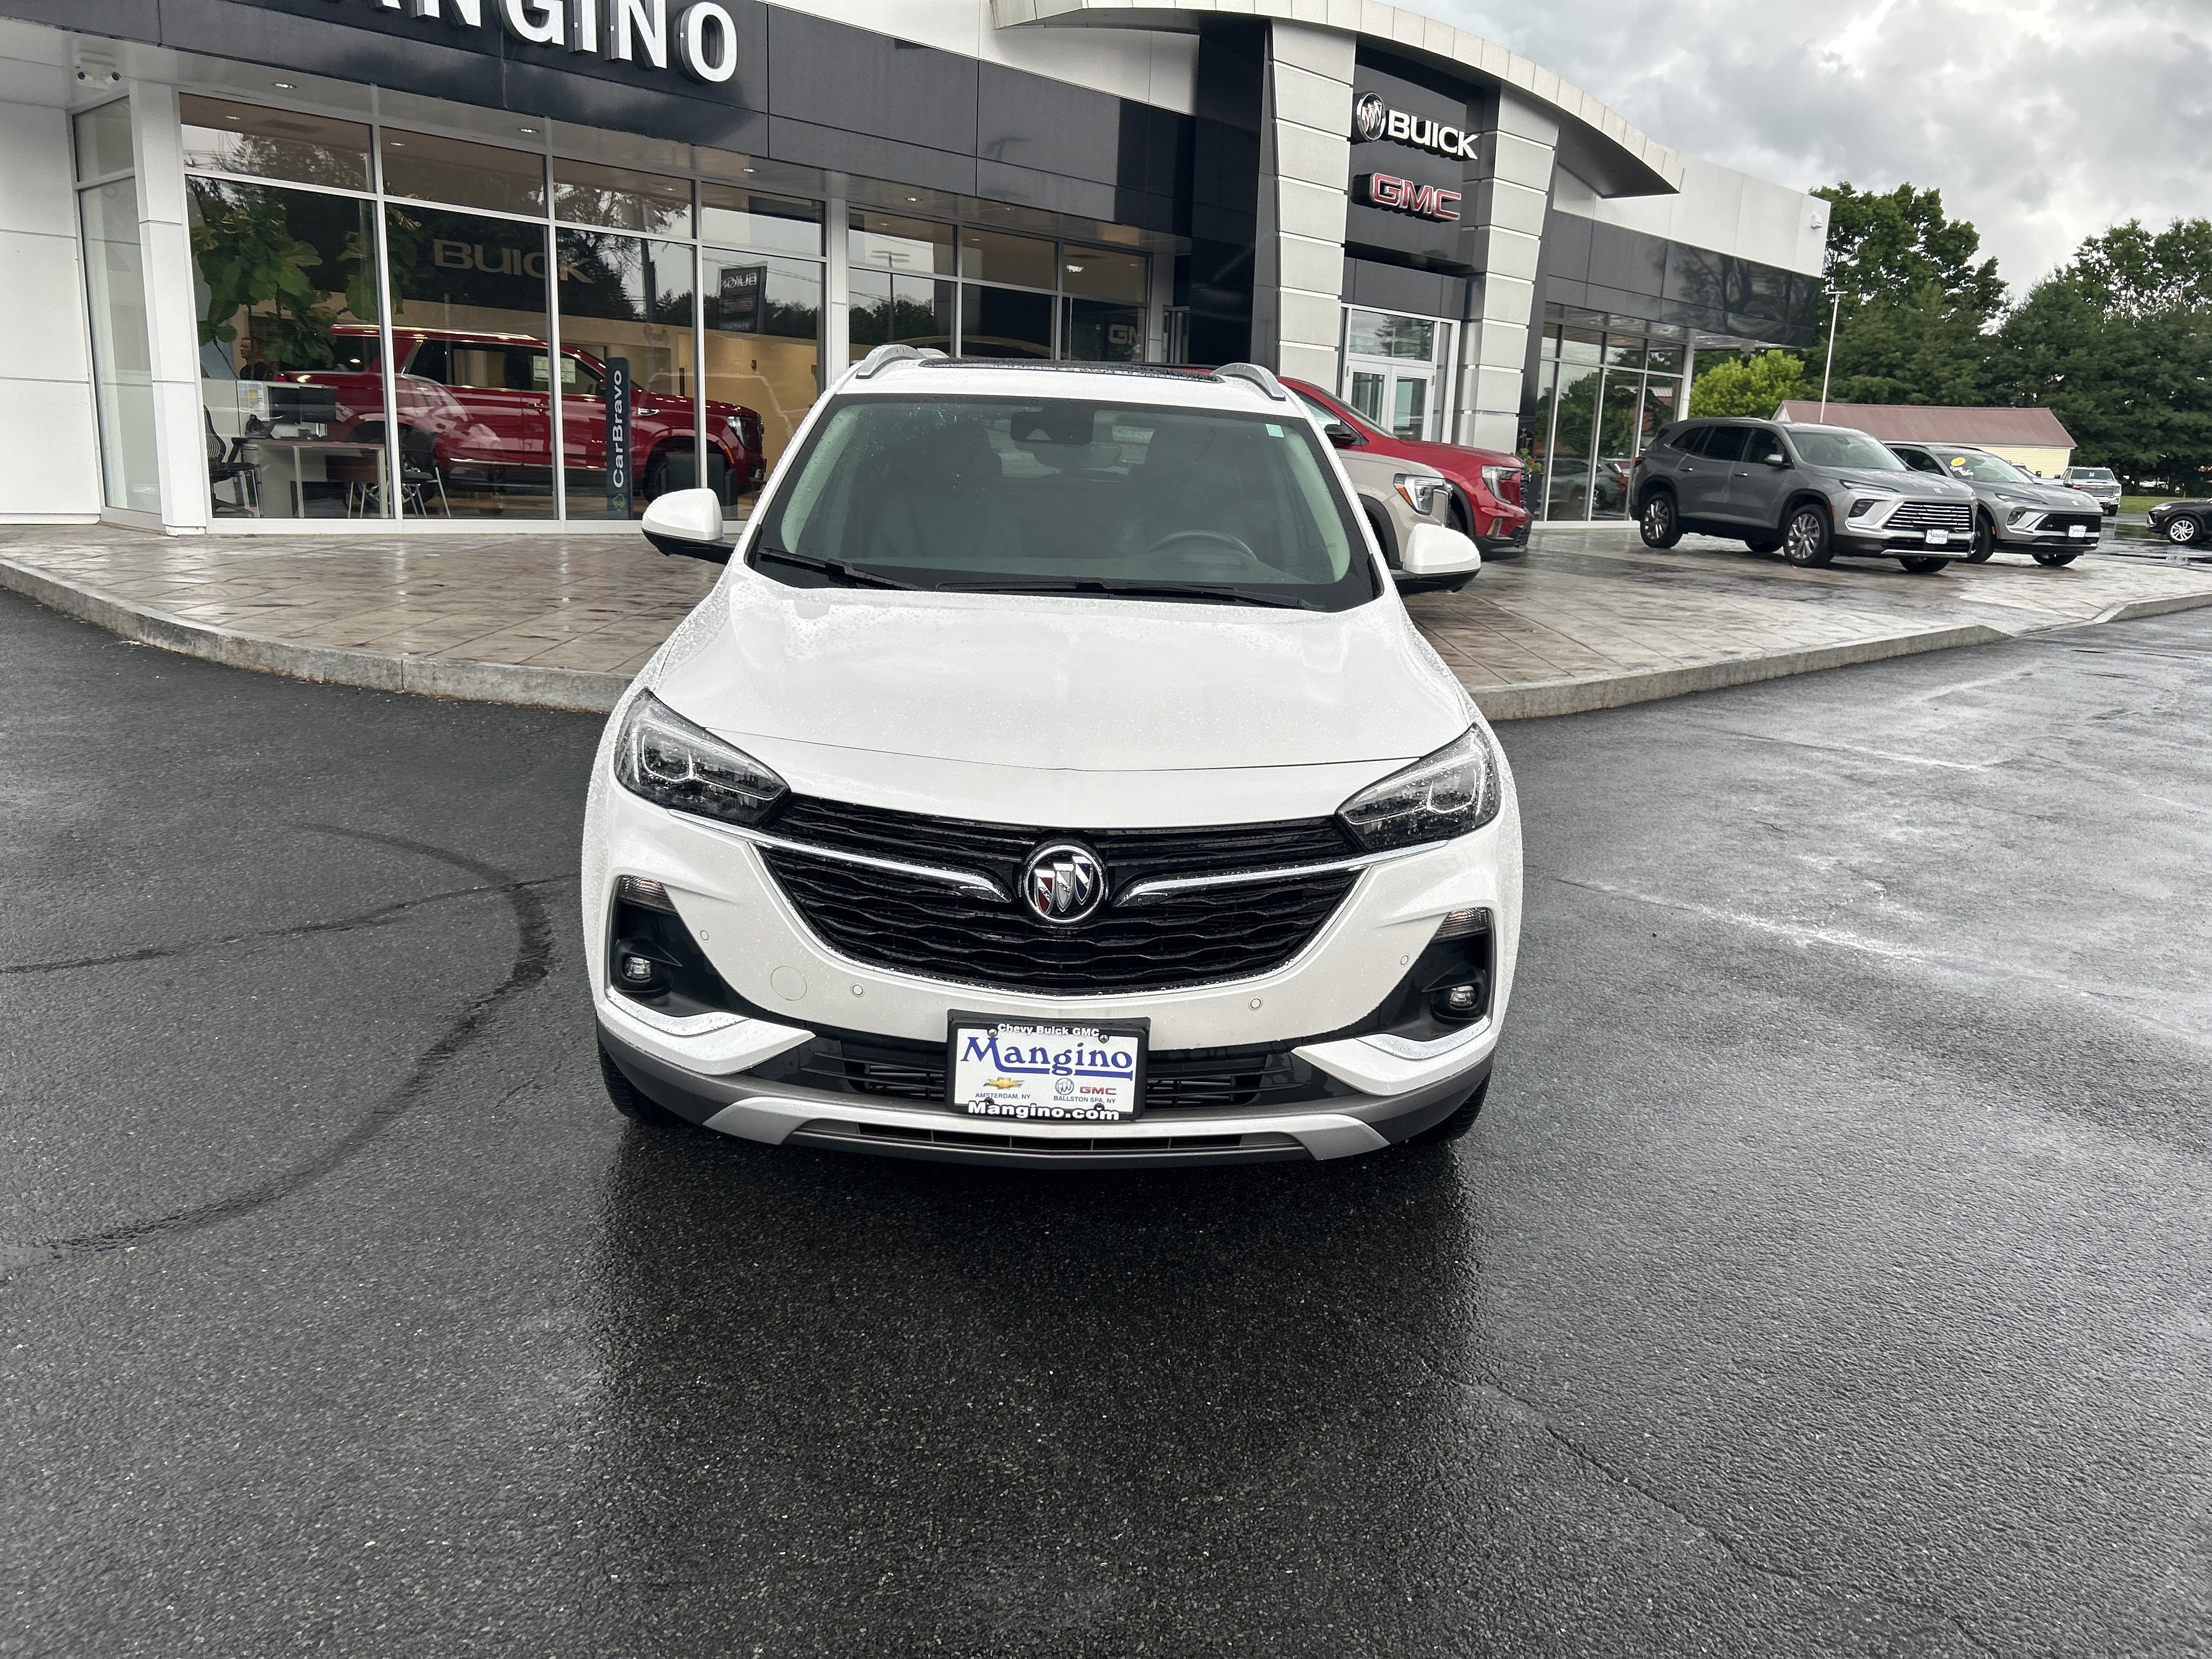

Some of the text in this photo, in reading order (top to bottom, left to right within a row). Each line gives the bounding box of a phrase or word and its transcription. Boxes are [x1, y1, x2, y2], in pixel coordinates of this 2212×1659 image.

[376, 0, 737, 82] GINO
[1388, 110, 1478, 159] BUICK
[1372, 173, 1461, 220] GMC
[433, 239, 596, 284] BUICK
[612, 370, 624, 488] CarBravo
[997, 1023, 1099, 1036] Chevy Buick GMC
[960, 1037, 1133, 1080] Mangino
[968, 1101, 1119, 1122] Mangino.com
[1080, 1086, 1116, 1095] GMC
